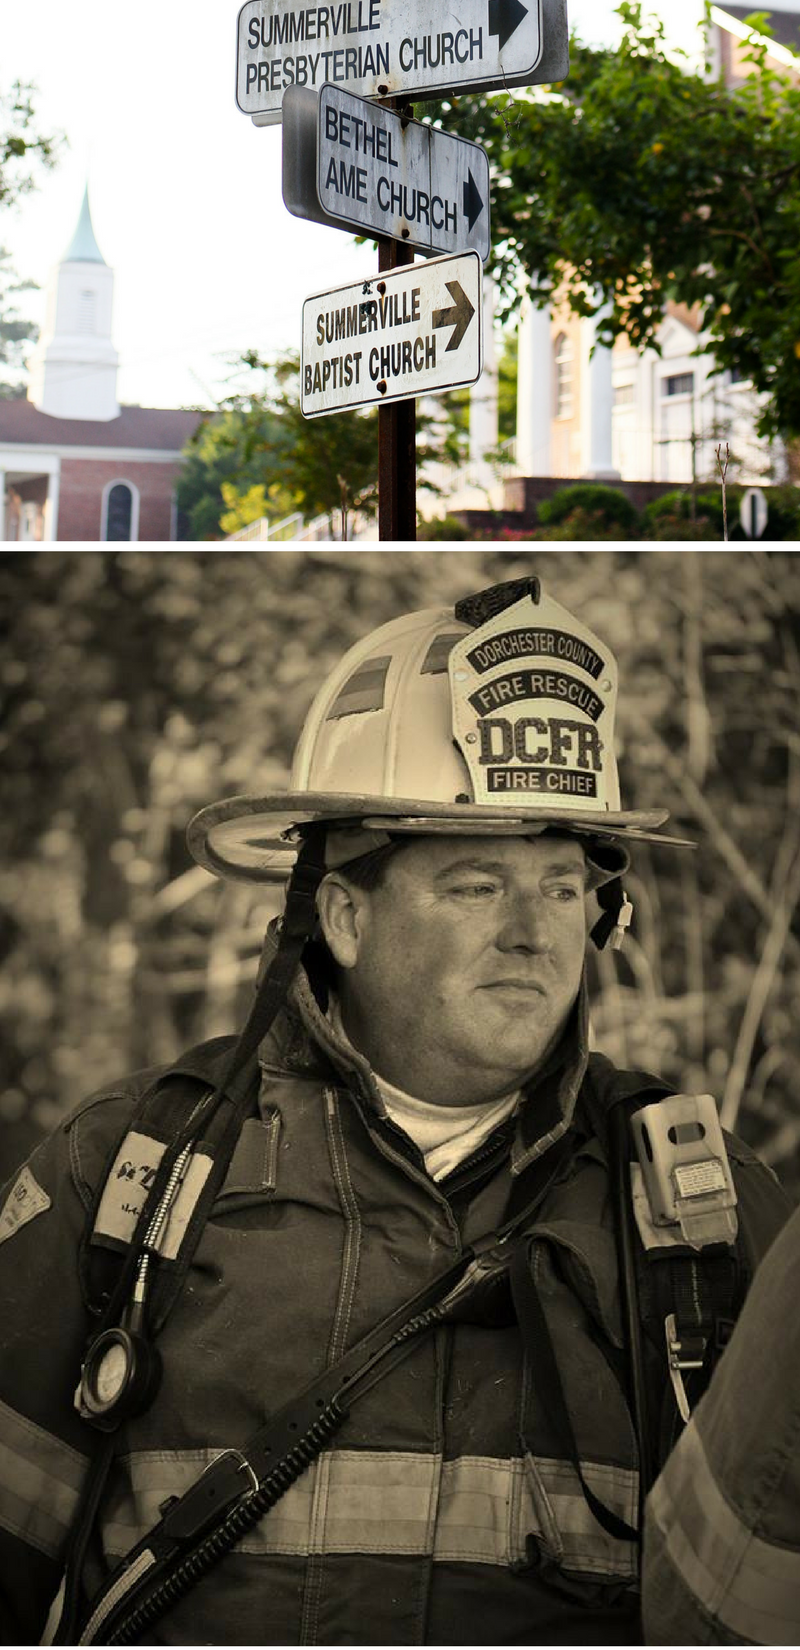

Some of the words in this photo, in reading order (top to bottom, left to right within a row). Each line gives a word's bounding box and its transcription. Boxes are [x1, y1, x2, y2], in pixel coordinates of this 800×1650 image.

[246, 42, 390, 95] PRESBYTERIAN
[399, 27, 483, 72] CHURCH
[325, 105, 399, 168] BETHEL
[325, 156, 368, 204] AME
[377, 176, 457, 234] CHURCH
[316, 287, 421, 346] SUMMERVILLE
[305, 351, 362, 397] BAPTIST
[369, 334, 436, 381] CHURCH
[475, 632, 555, 668] DORCHESTER
[557, 636, 600, 676] COUNTY
[479, 676, 526, 708] FIRE
[530, 674, 599, 717] RESCUE
[477, 717, 603, 773] DCFR
[493, 771, 541, 789] FIRE
[546, 772, 593, 794] CHIEF
